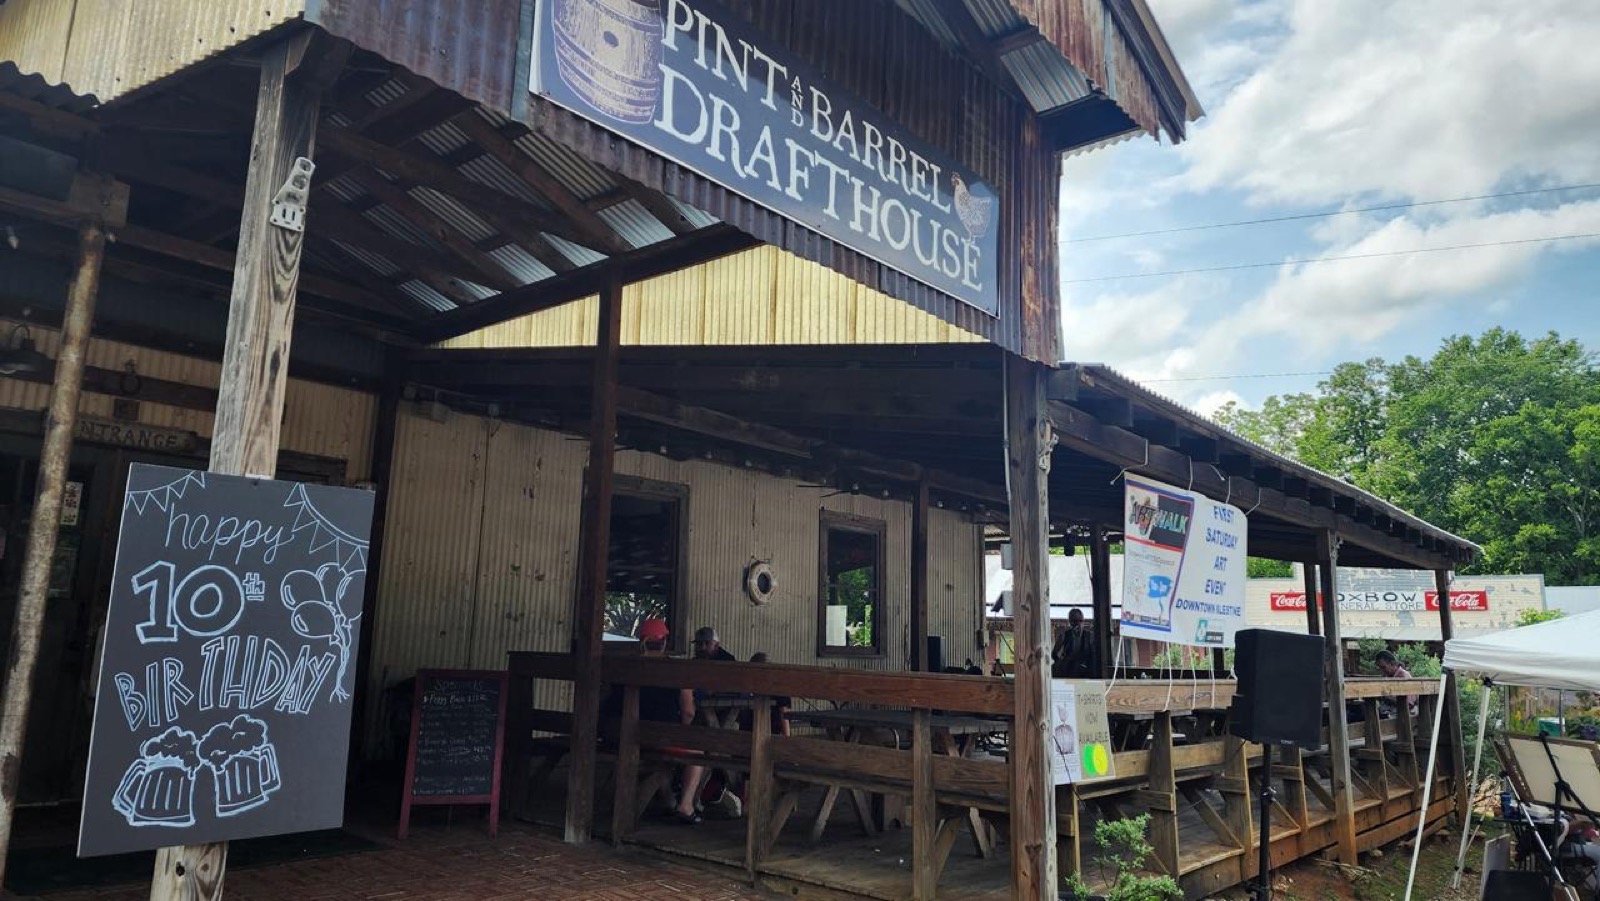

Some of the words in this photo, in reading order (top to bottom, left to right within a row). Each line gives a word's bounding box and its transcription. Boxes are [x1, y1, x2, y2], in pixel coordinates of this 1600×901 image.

[660, 0, 788, 111] PINT
[790, 75, 804, 127] AND
[809, 86, 951, 215] BARREL
[654, 63, 982, 292] DRAFTHOUSE
[1213, 505, 1235, 524] FIRST
[164, 502, 298, 565] happy
[1205, 526, 1239, 549] SATURDAY
[1213, 555, 1228, 572] ART
[1204, 579, 1227, 596] EVENT
[1175, 598, 1215, 614] DOWNTOWN
[1341, 602, 1376, 610] NERAL
[1385, 602, 1422, 610] STORE
[114, 635, 337, 731] BIRTHDAY
